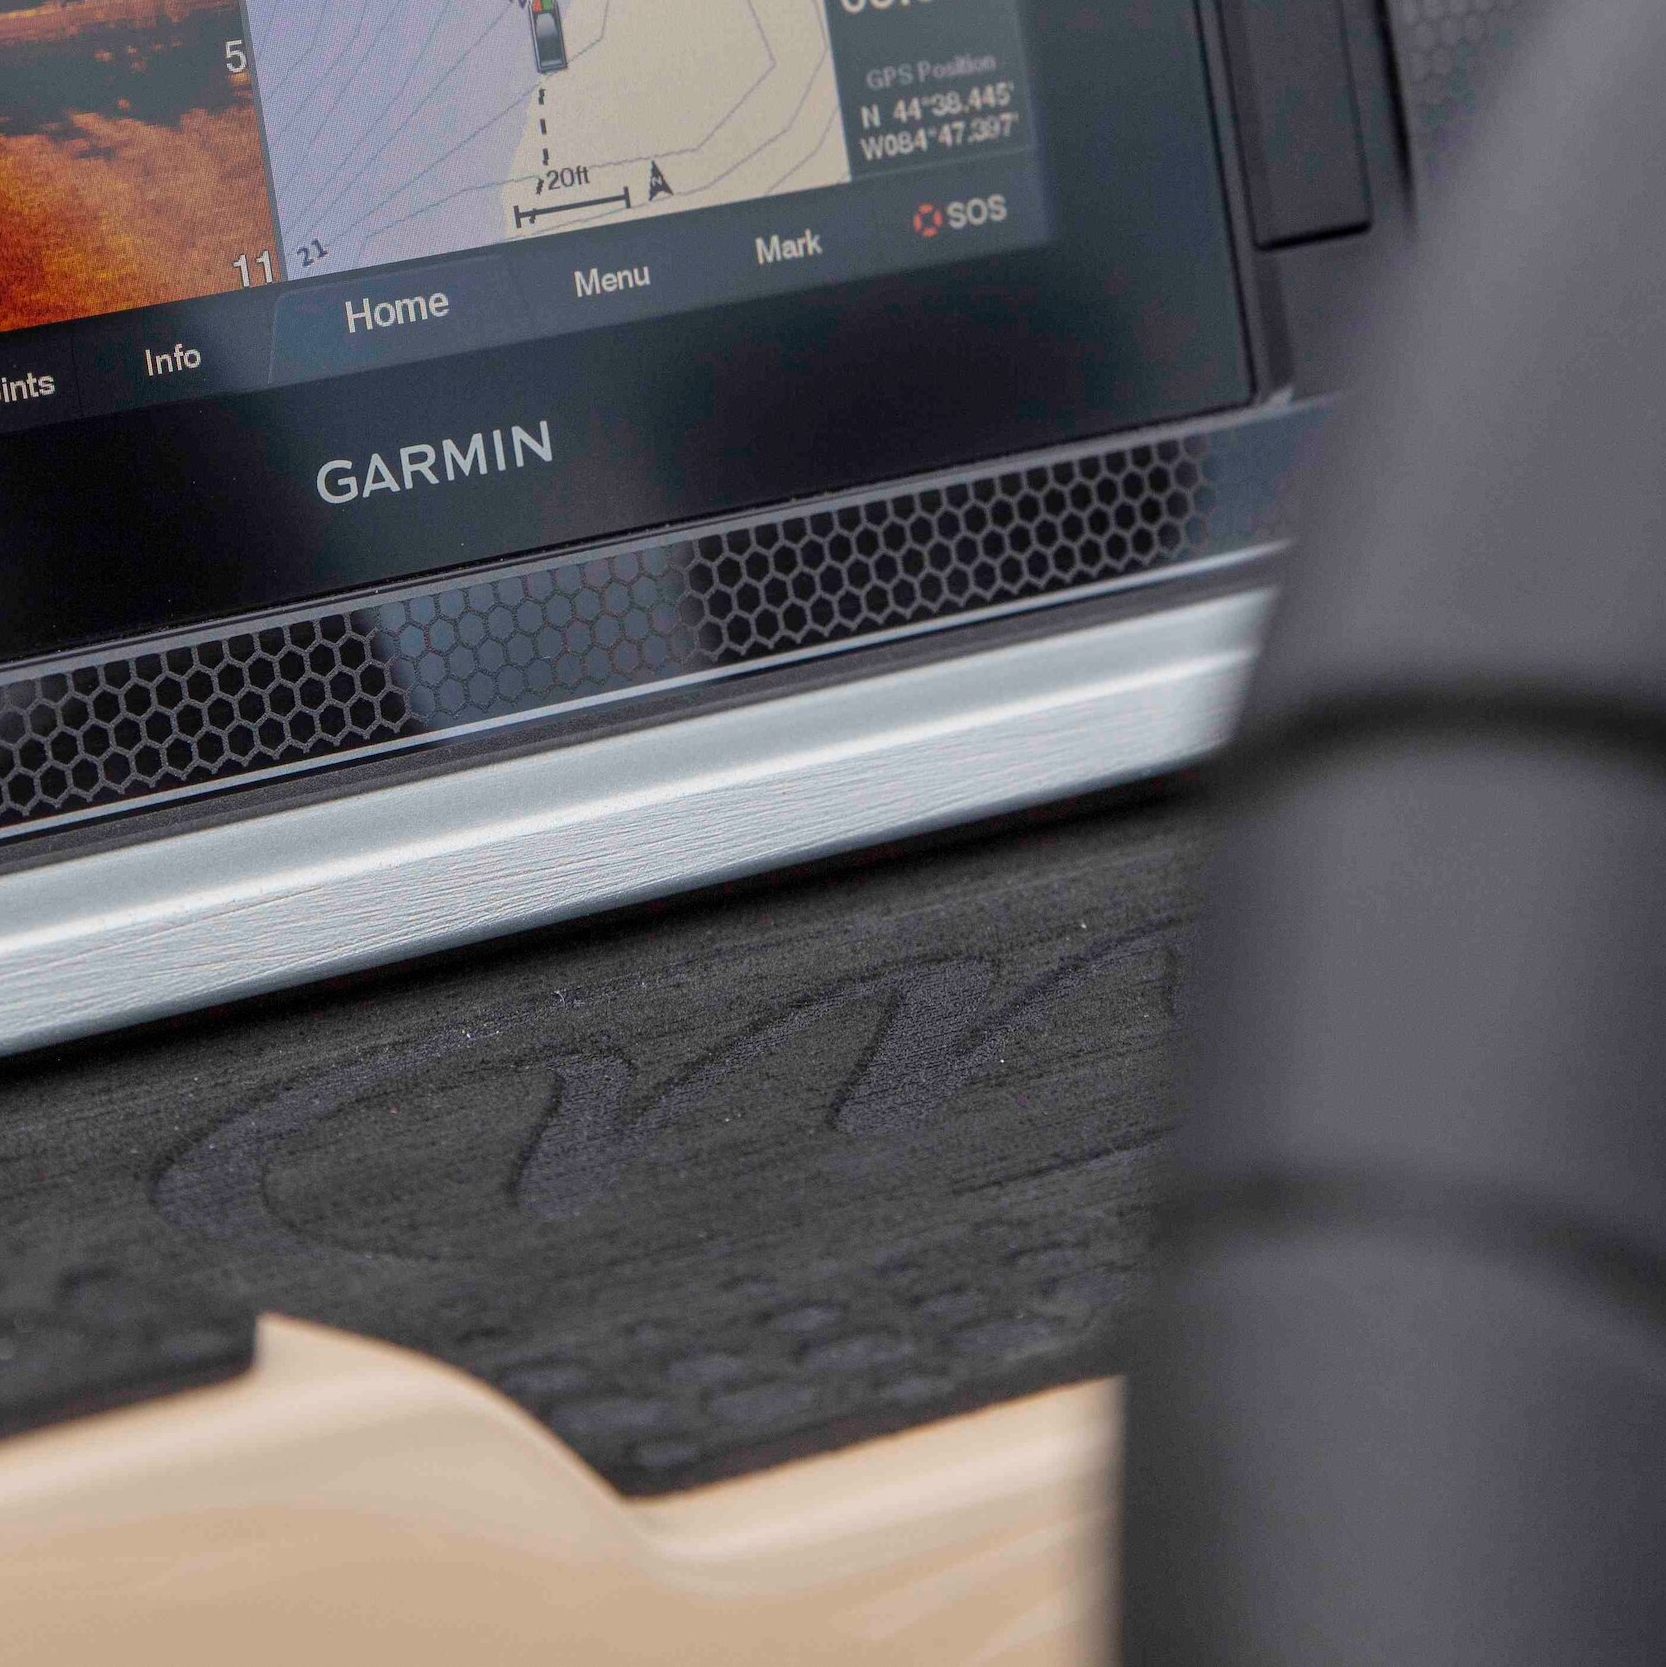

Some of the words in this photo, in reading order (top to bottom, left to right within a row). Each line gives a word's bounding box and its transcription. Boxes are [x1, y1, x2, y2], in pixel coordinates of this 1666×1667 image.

[224, 39, 248, 74] 5
[866, 63, 914, 90] GPS
[917, 54, 997, 82] Position
[860, 104, 881, 129] N
[546, 164, 590, 191] 20ft
[946, 193, 1008, 230] SOS
[296, 238, 329, 268] 21
[755, 229, 823, 265] Mark
[231, 249, 275, 289] 11
[574, 261, 651, 299] Menu
[344, 288, 451, 335] Home
[145, 343, 201, 377] Info
[315, 419, 554, 505] GARMIN
